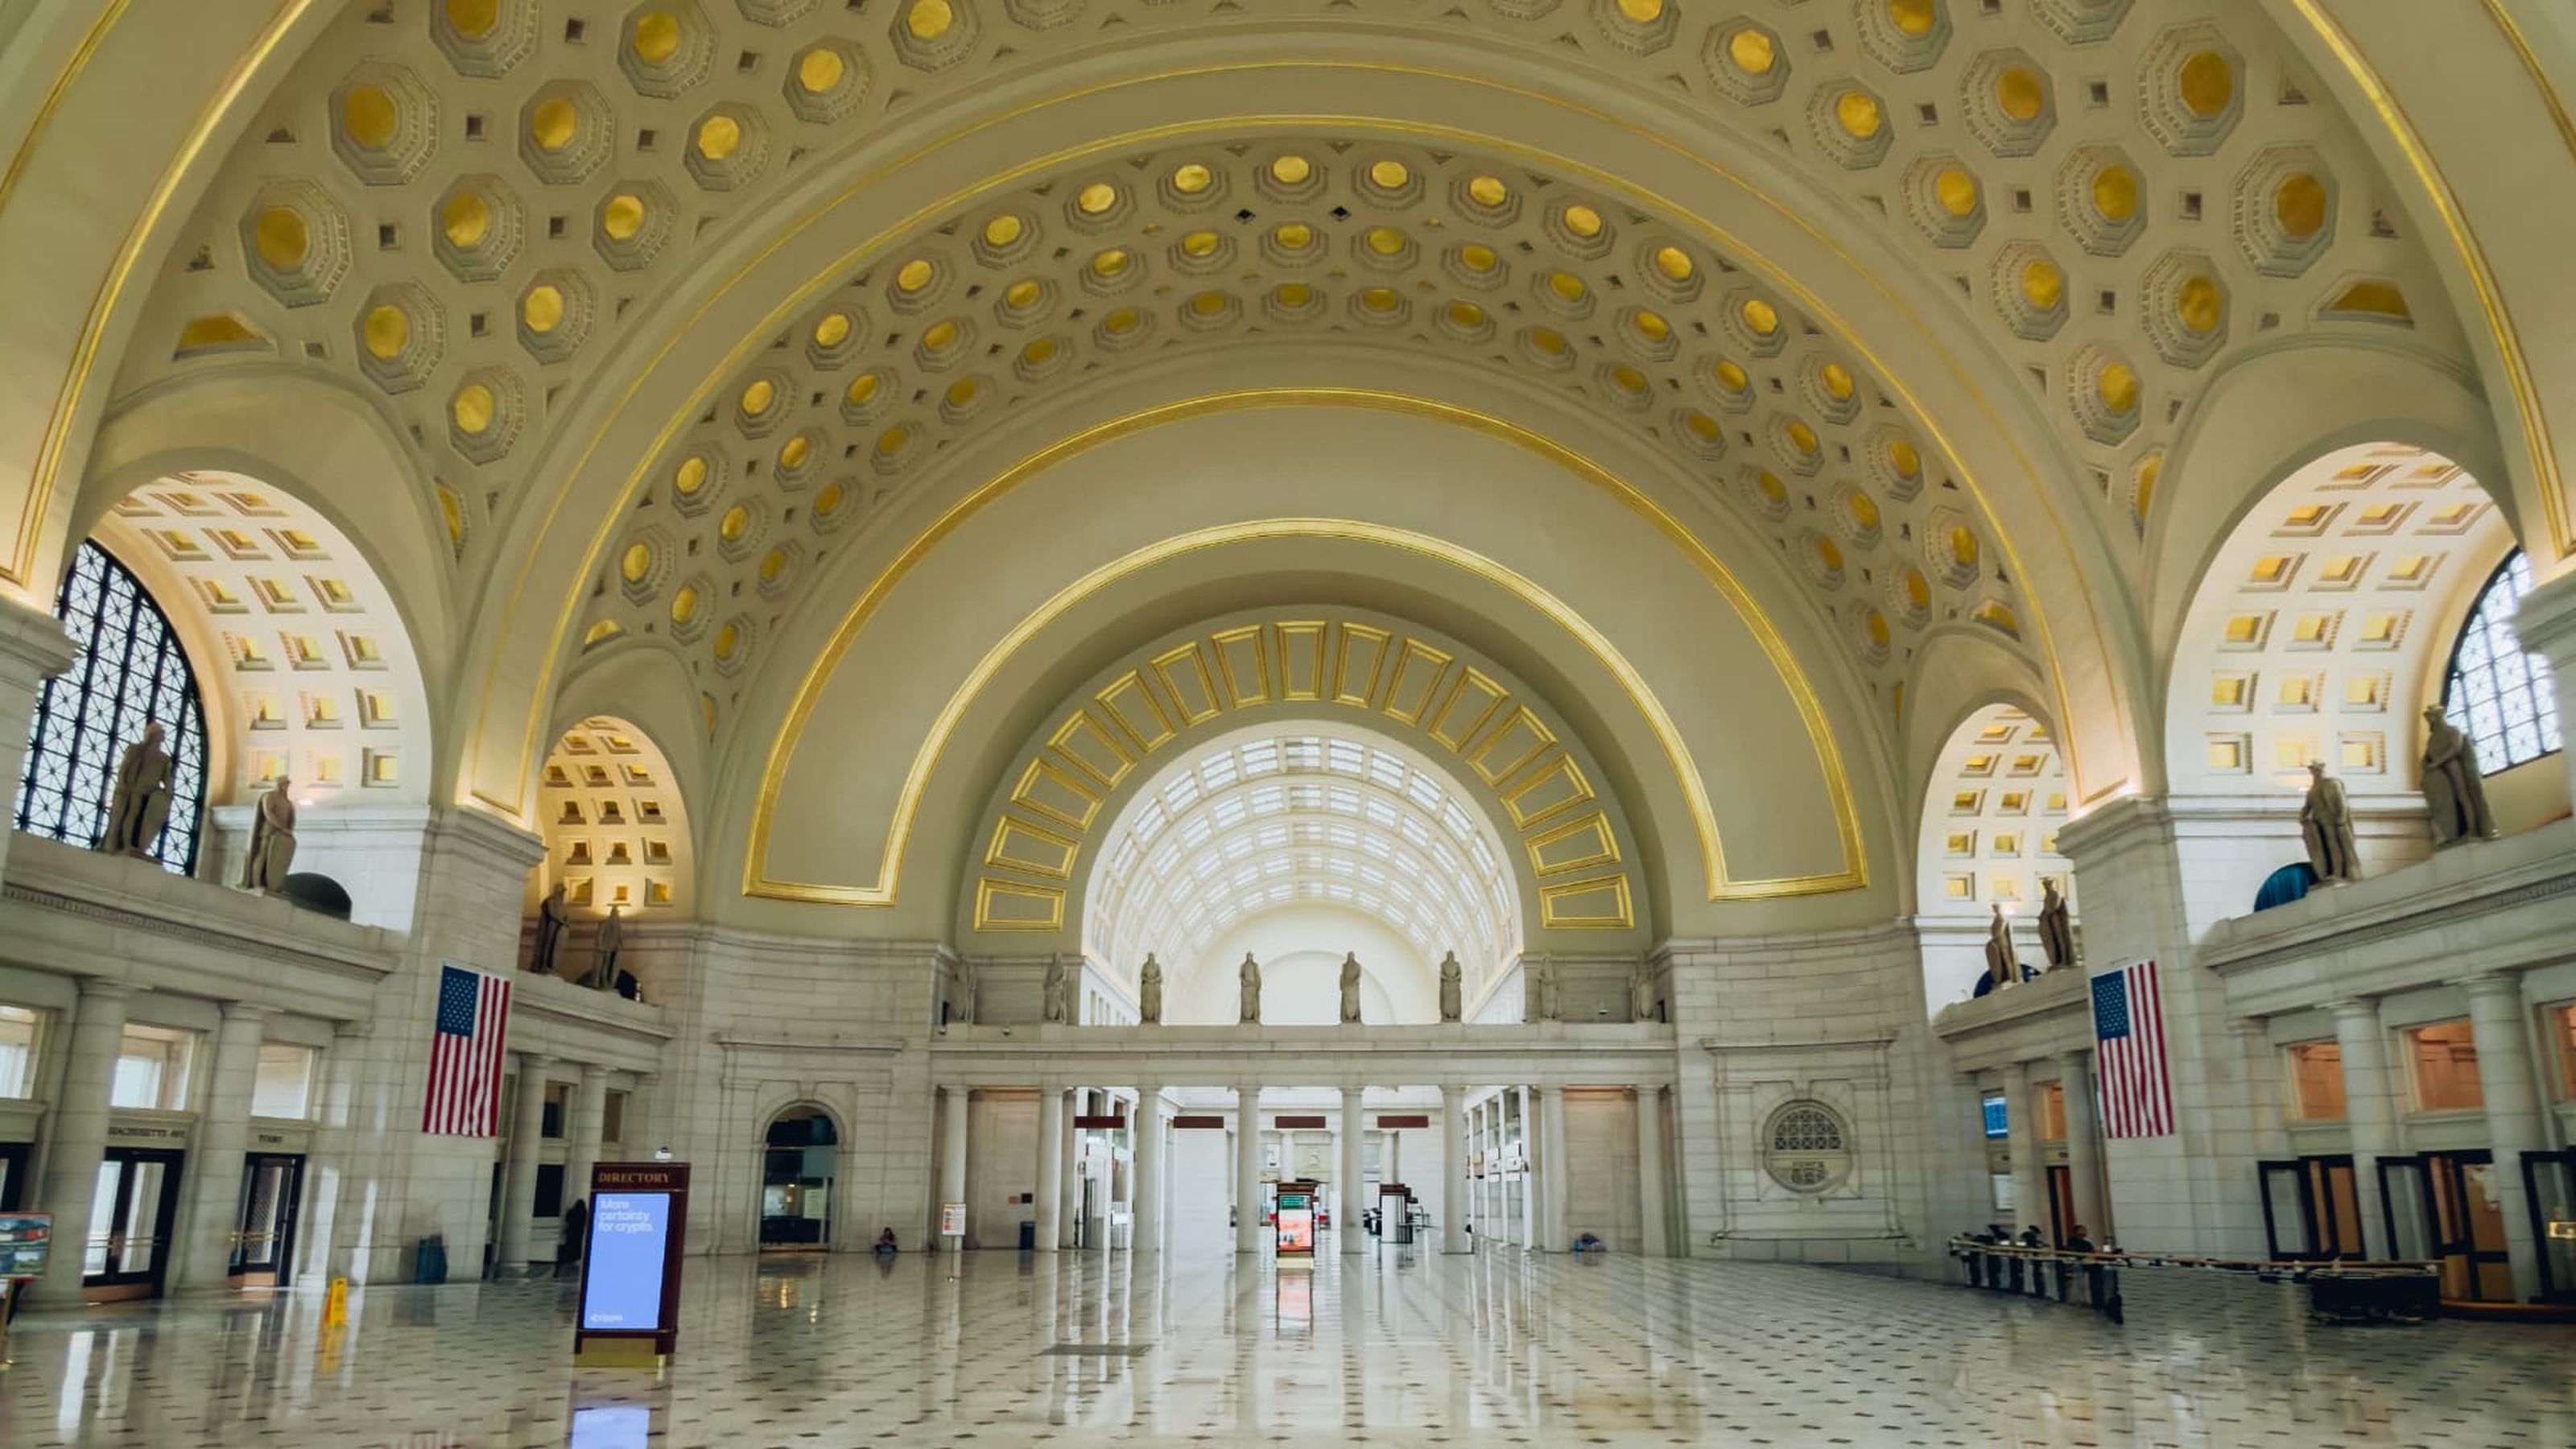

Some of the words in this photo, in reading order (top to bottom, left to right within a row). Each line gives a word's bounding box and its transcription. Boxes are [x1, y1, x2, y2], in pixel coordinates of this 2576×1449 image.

[599, 1172, 669, 1183] DIRECTORY
[600, 1199, 630, 1209] More
[600, 1212, 650, 1223] certainty
[598, 1222, 614, 1232] for
[614, 1223, 654, 1235] crypto.
